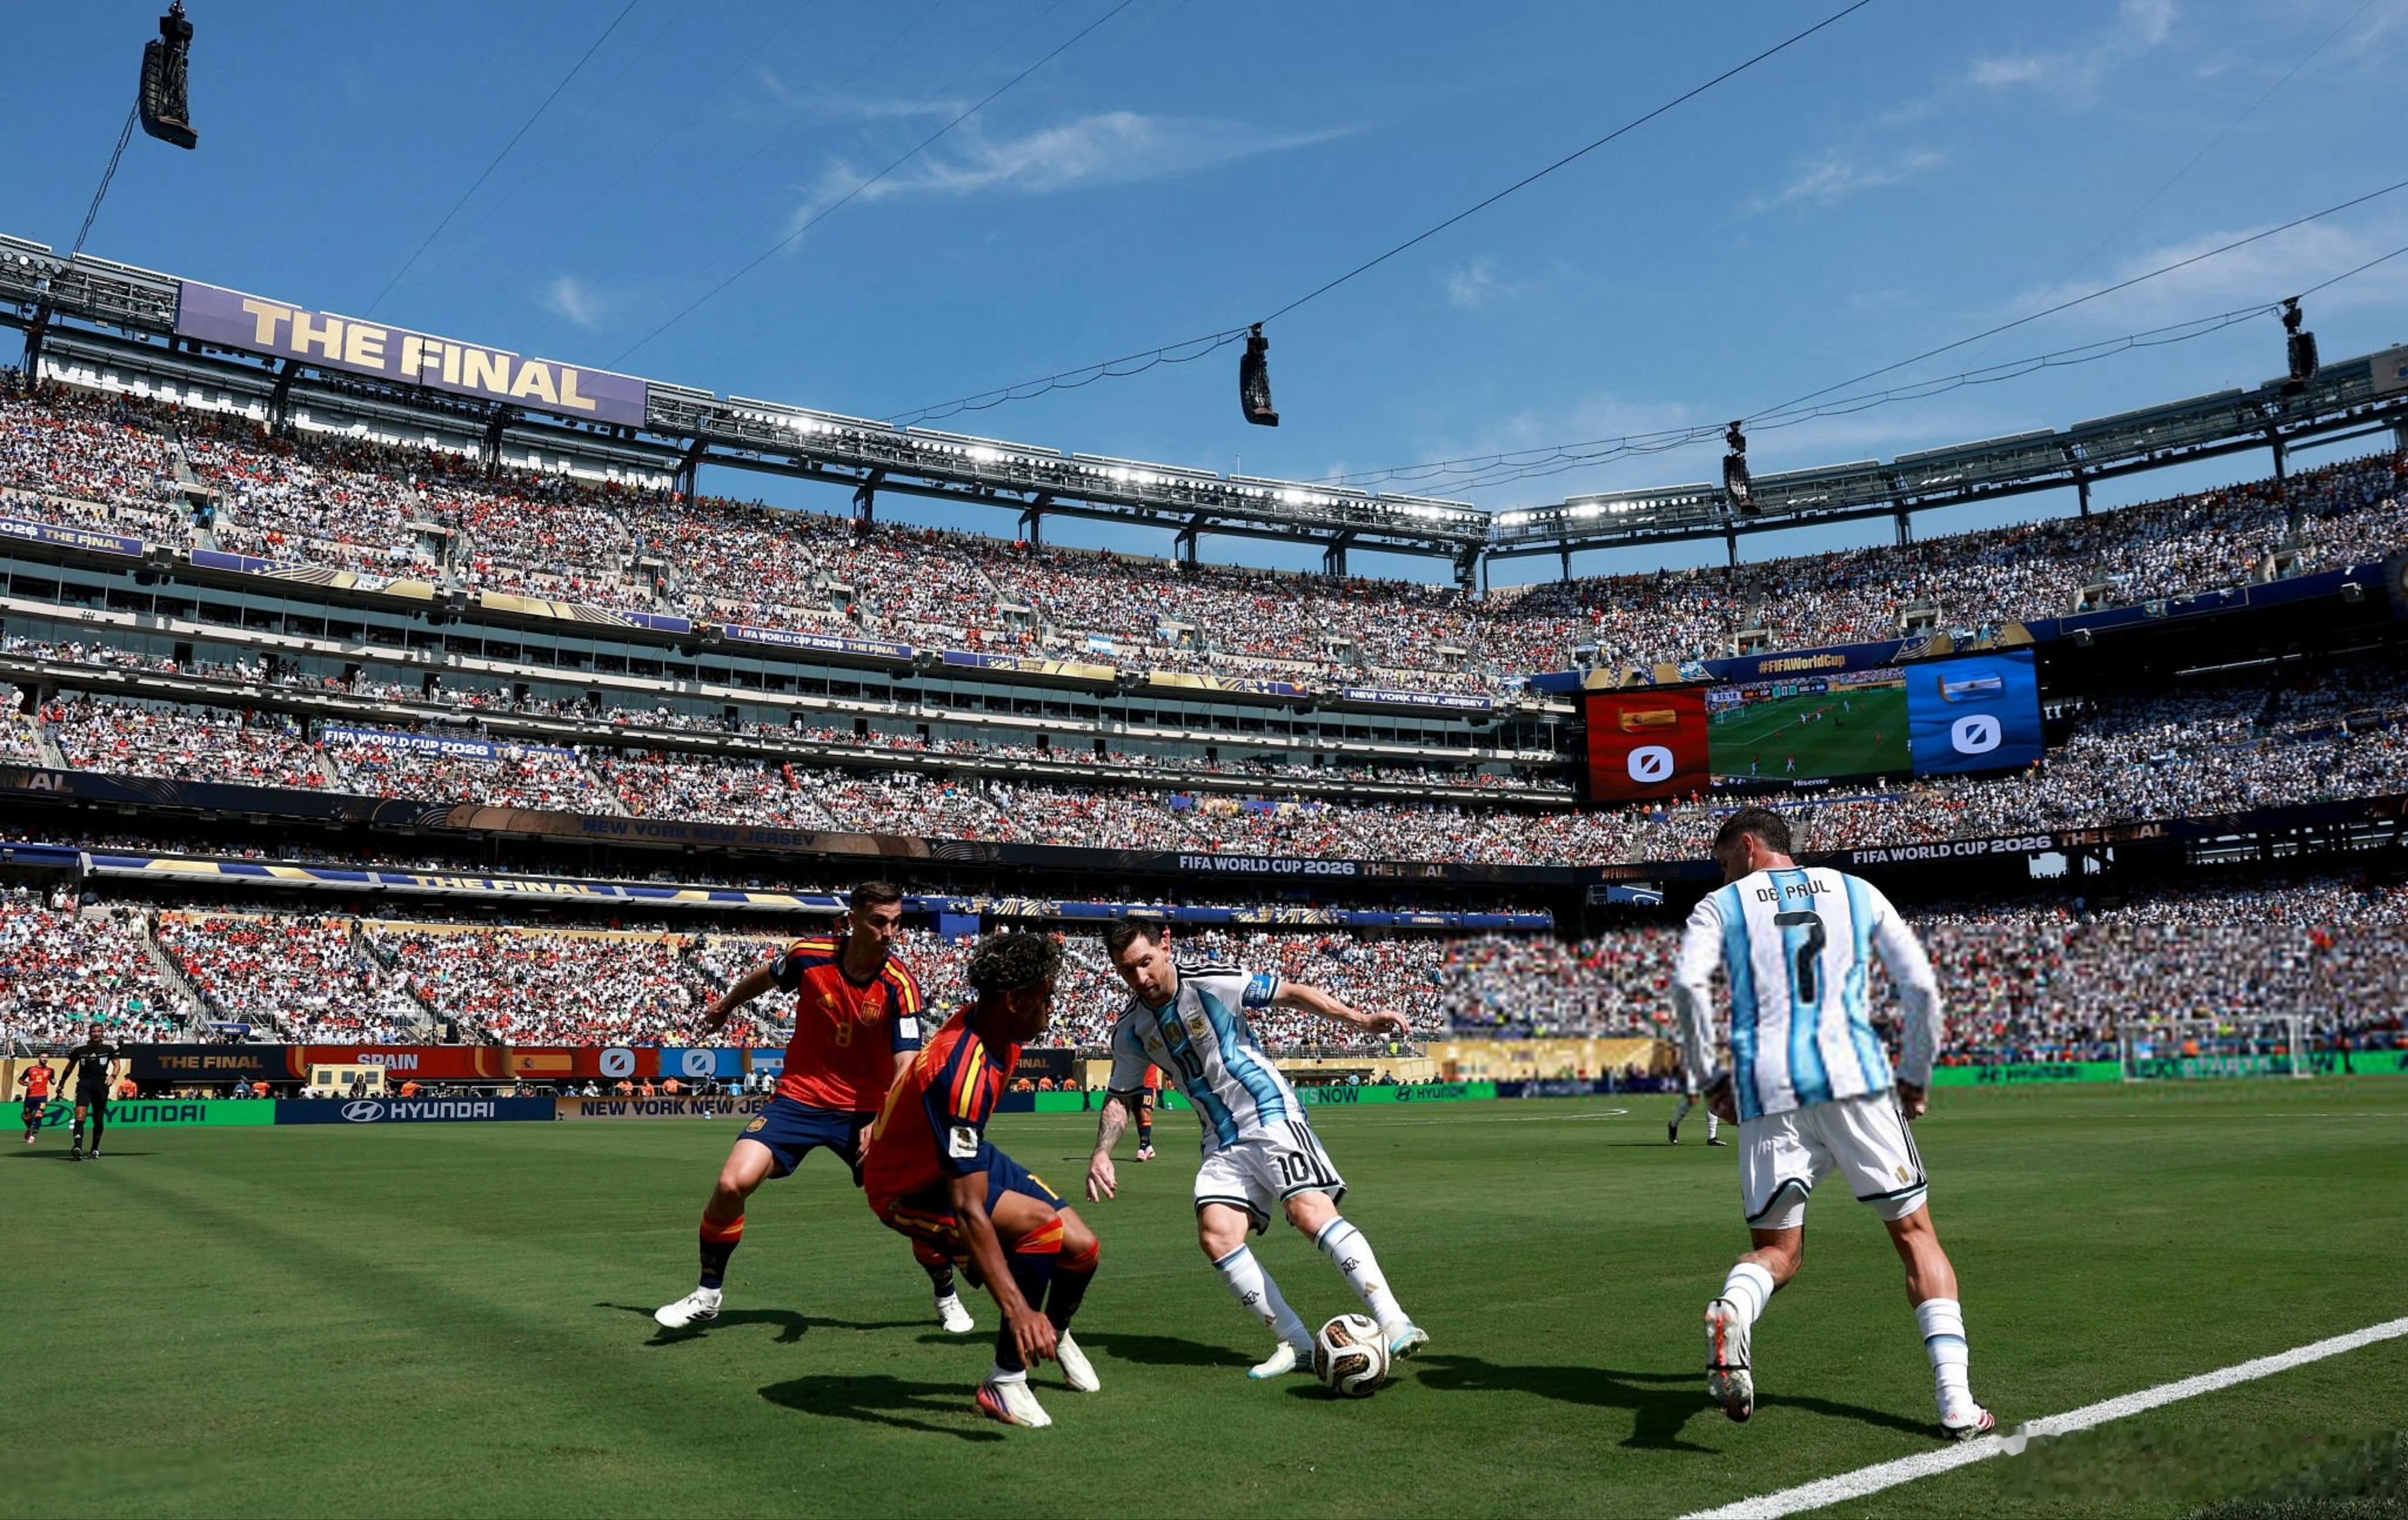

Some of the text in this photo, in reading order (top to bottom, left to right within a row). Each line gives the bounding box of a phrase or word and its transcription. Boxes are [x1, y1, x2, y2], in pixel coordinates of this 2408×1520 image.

[243, 299, 596, 410] THE FINAL
[0, 522, 124, 550] 026 THE FINAL
[738, 628, 899, 655] FIFA WORLD CUP 2026 THE FINAL
[1759, 654, 1846, 674] #FIFAWorldCup
[1350, 690, 1484, 707] NEW YORK NEW JERSEY
[325, 731, 355, 745] FIFA
[357, 733, 409, 747] WORLD
[411, 738, 439, 749] CUP
[441, 741, 489, 755] 2026
[1952, 715, 2001, 754] 0
[1628, 745, 1674, 782] 0
[1793, 778, 1829, 788] Hisense
[583, 818, 815, 846] NEW YORK NEW JERSEY
[1853, 824, 2168, 864] FIFA WORLD CUP 2026 THE FINAL
[1179, 855, 1210, 870] FIFA
[1215, 857, 1269, 872] WORLD
[1272, 859, 1302, 873] CUP
[1304, 861, 1355, 875] 2026
[1362, 862, 1394, 876] THE
[407, 875, 603, 896] THE FINAL
[1756, 880, 1831, 902] DE PAUL
[1774, 910, 1826, 1003] 7
[835, 1022, 852, 1047] 8
[160, 1056, 263, 1069] THE FINAL
[357, 1053, 418, 1070] SPAIN
[600, 1049, 636, 1077] 0
[682, 1049, 715, 1077] 0
[1016, 1059, 1050, 1068] INAL
[1176, 1049, 1204, 1082] 10
[391, 1102, 494, 1118] HYUNDAI
[581, 1100, 769, 1116] NEW YORK NEW JE
[1143, 1095, 1152, 1105] 10
[1277, 1151, 1309, 1186] 10
